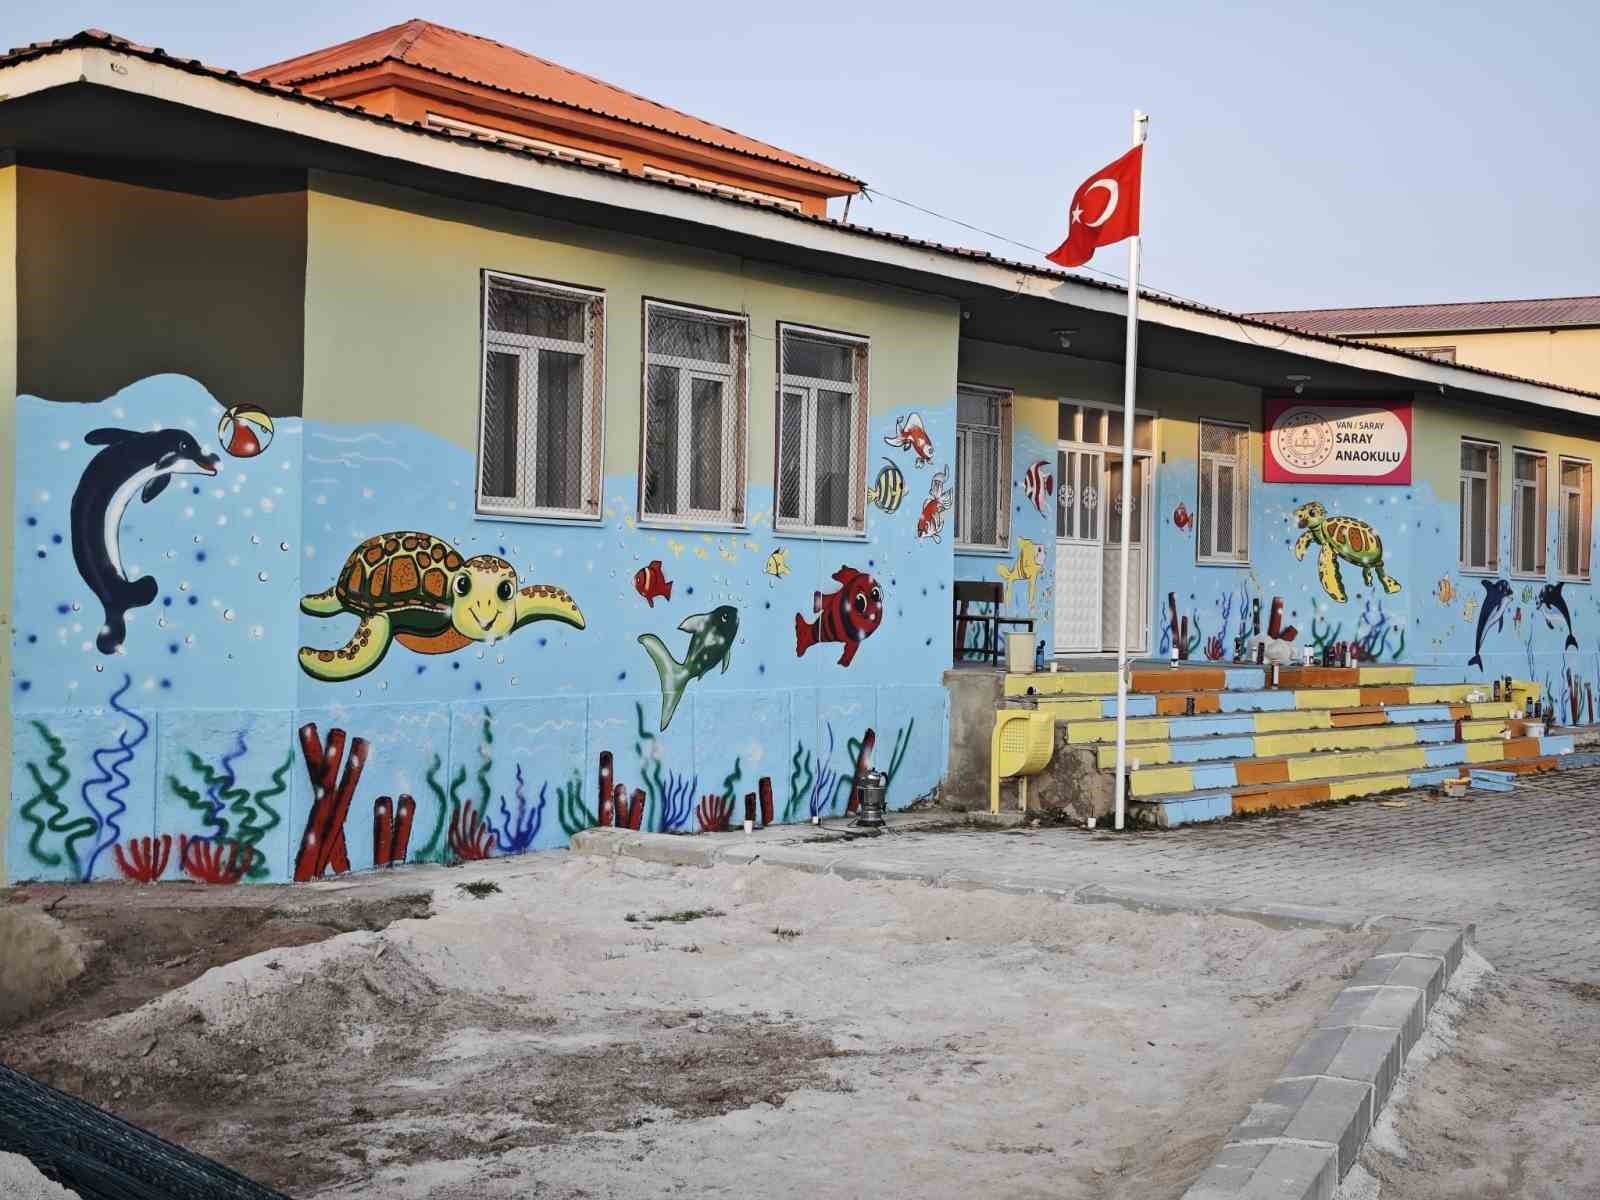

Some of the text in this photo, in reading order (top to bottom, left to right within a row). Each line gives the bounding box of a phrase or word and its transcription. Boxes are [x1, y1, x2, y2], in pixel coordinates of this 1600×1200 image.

[1336, 421, 1352, 430] VAN
[1359, 422, 1384, 431] SARAY
[1336, 433, 1373, 444] SARAY
[1336, 451, 1400, 462] ANAOKULU
